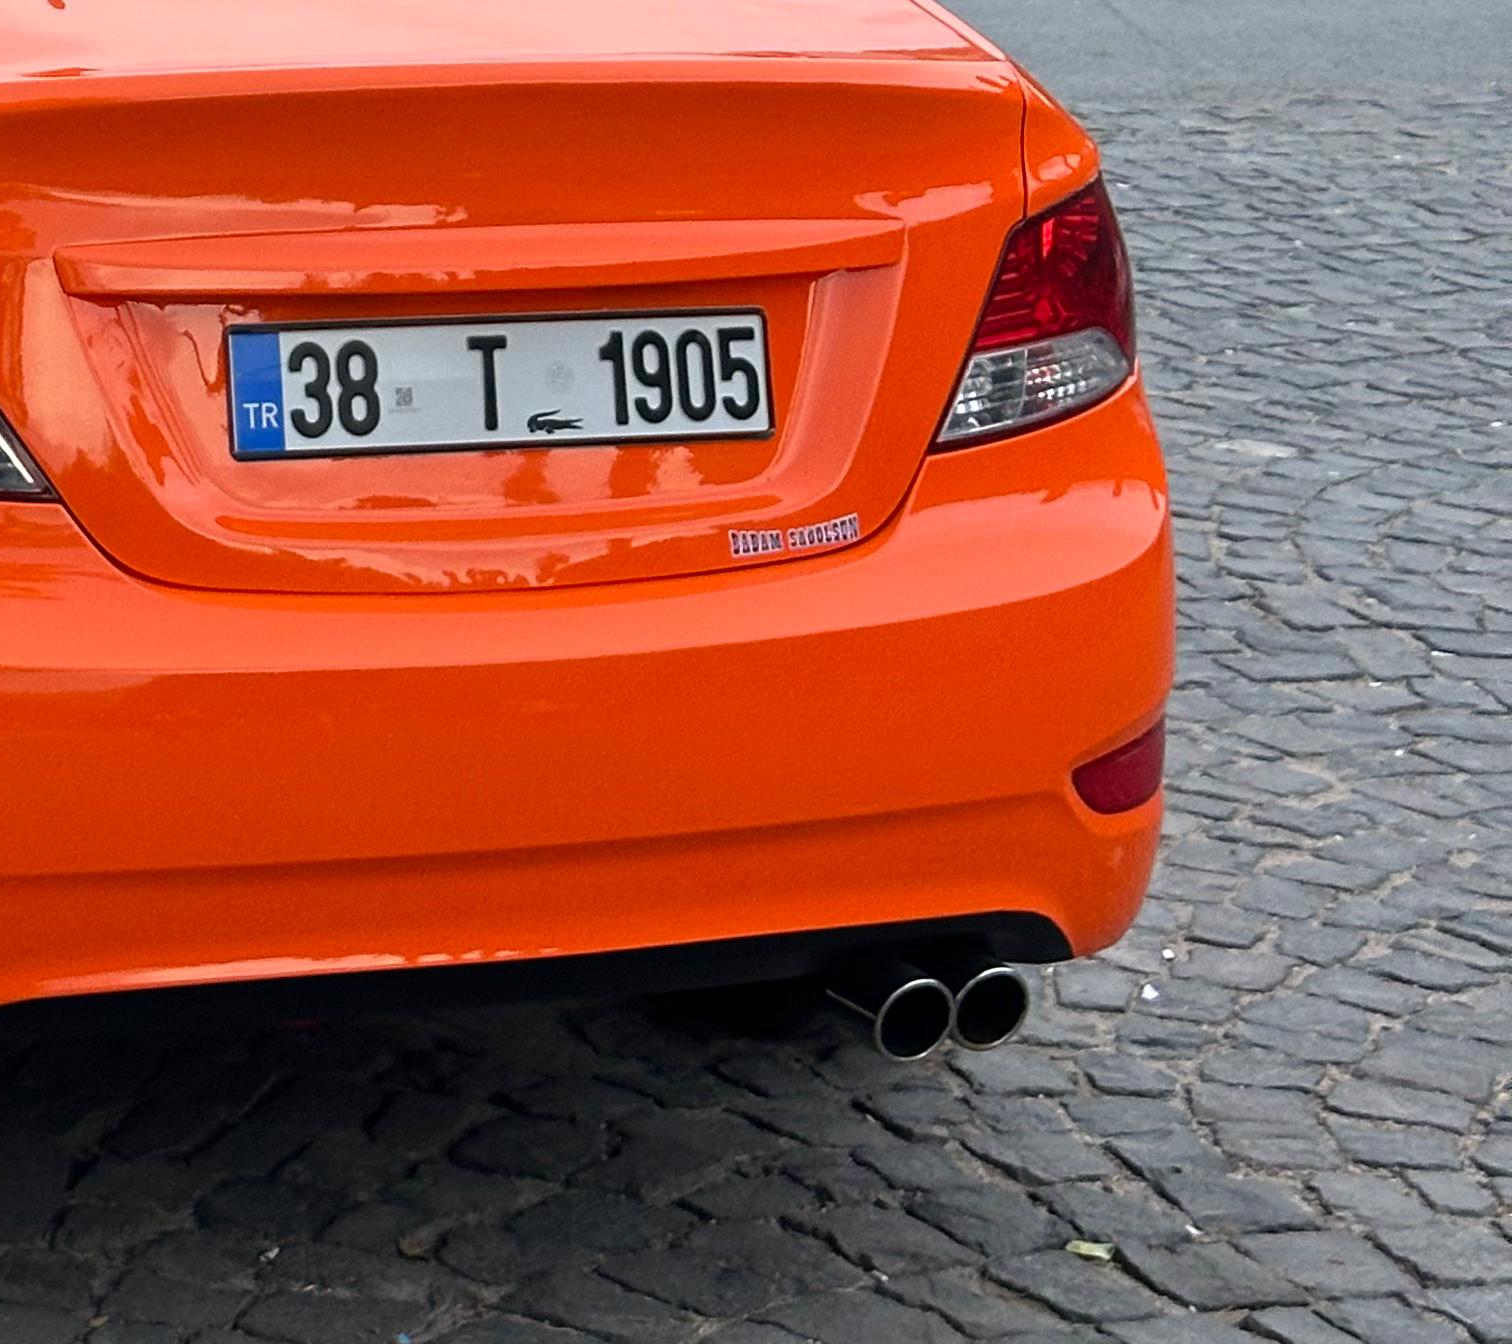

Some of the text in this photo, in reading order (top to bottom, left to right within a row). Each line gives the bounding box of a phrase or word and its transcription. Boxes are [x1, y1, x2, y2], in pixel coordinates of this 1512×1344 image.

[242, 401, 280, 431] TR
[288, 325, 760, 440] 38 T 1905
